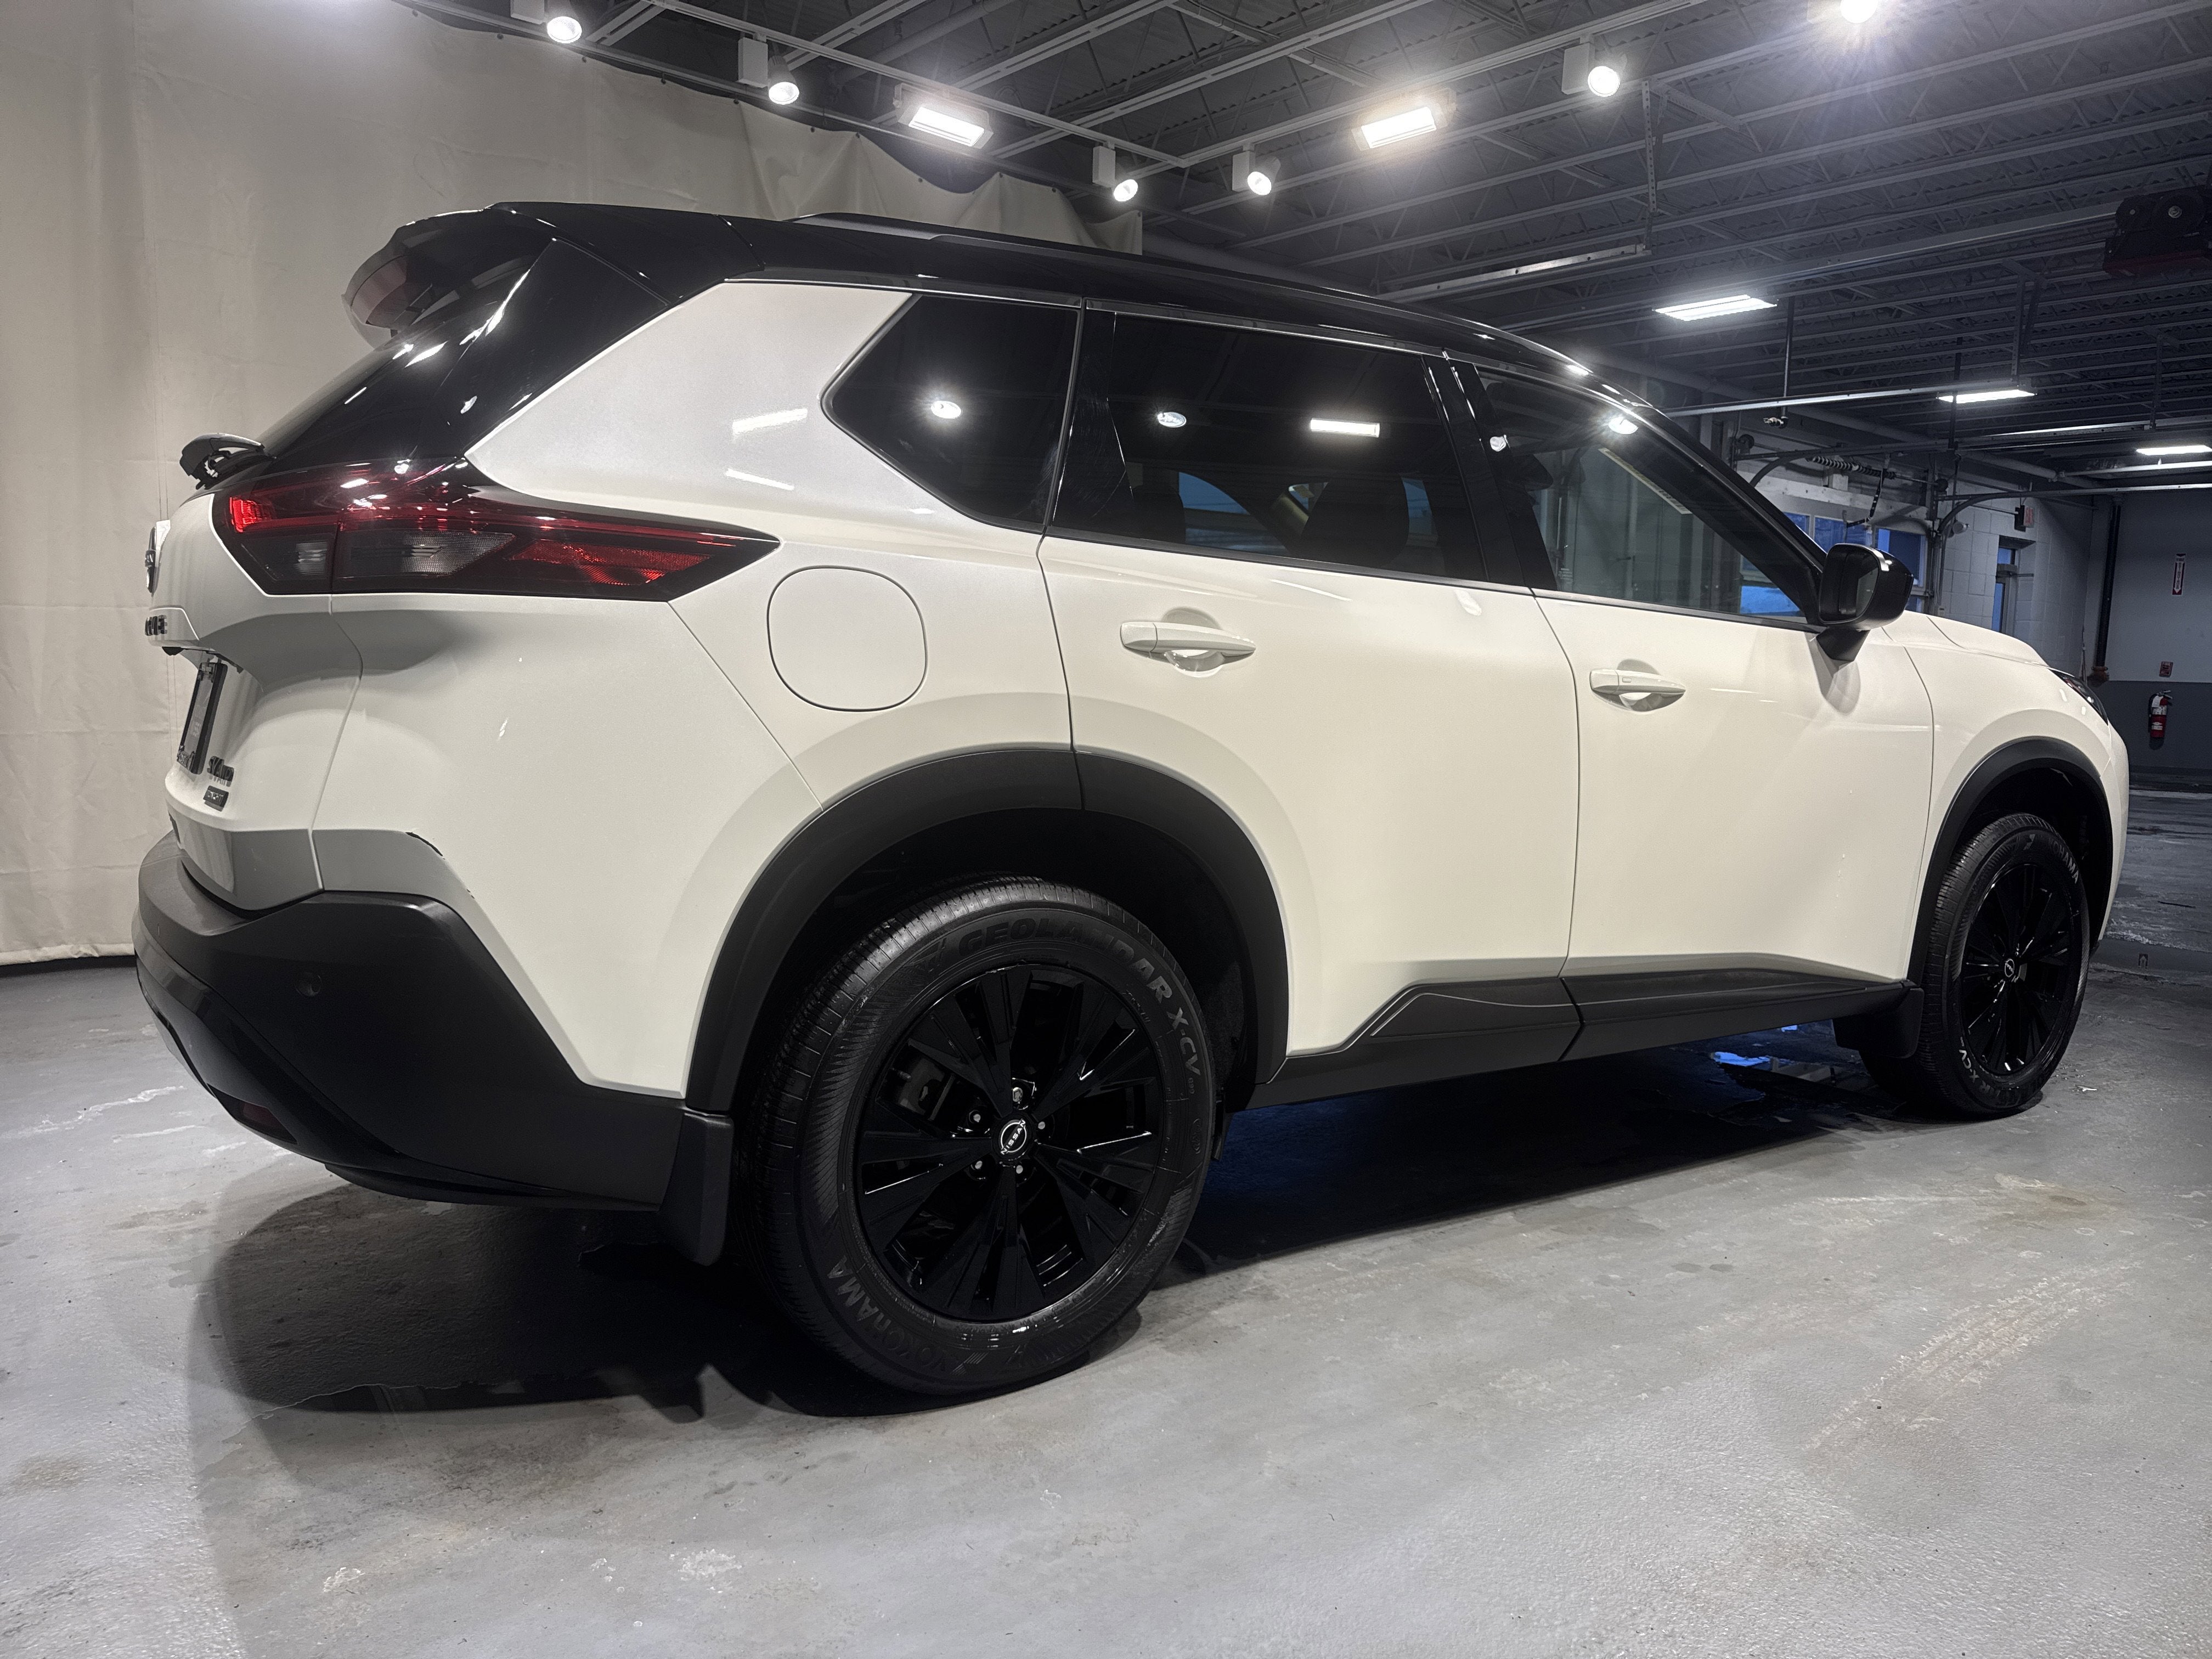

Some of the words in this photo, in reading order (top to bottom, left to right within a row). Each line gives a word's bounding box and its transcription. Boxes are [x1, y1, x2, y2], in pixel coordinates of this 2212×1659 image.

[958, 917, 1173, 1003] GEOLANDAR
[1167, 1007, 1201, 1076] X-CV
[1000, 1118, 1026, 1155] NISSAN
[826, 1255, 950, 1374] YOKOHAMA
